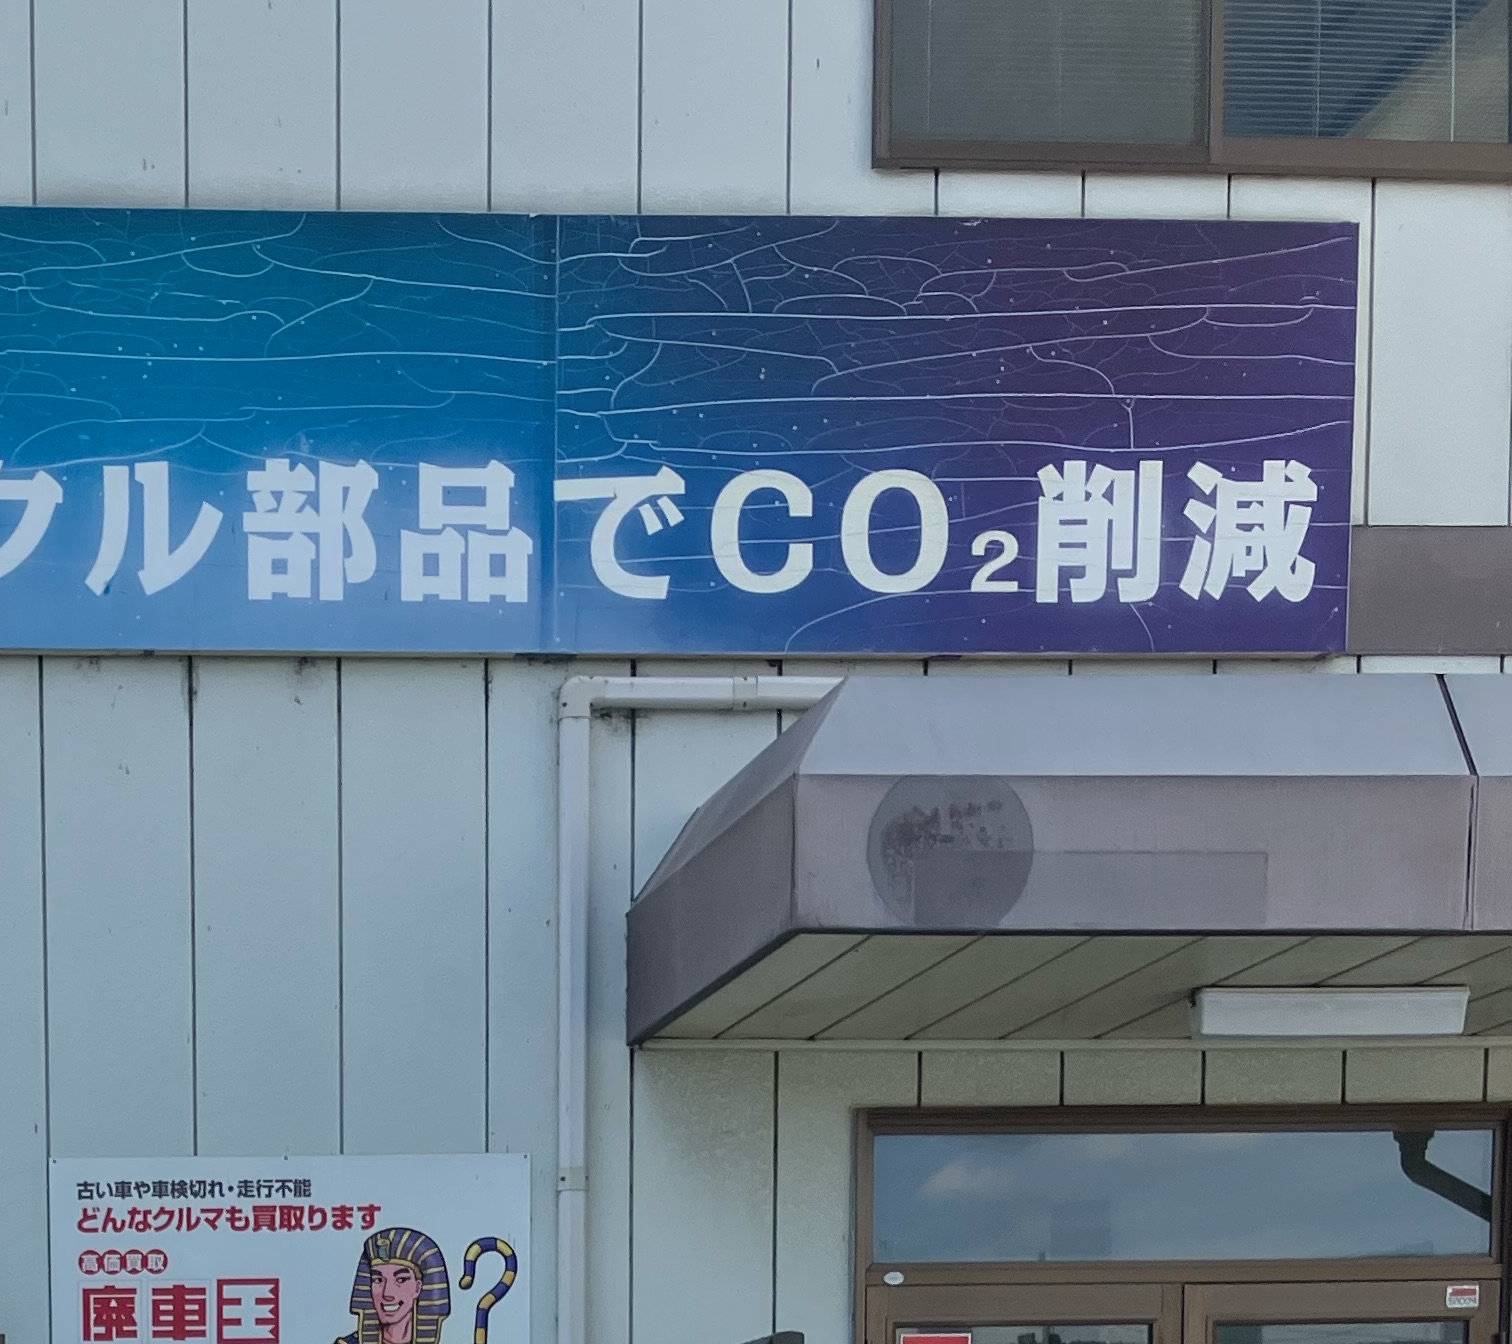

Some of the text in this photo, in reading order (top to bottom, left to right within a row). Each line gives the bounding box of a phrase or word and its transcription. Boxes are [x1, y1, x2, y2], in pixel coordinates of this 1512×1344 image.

[76, 1178, 312, 1200] 古い車や車検切れ・走行不能
[76, 1204, 382, 1233] どんなクルマも買取ります
[80, 1253, 166, 1272] 高価買取
[82, 1278, 280, 1344] 廃車王
